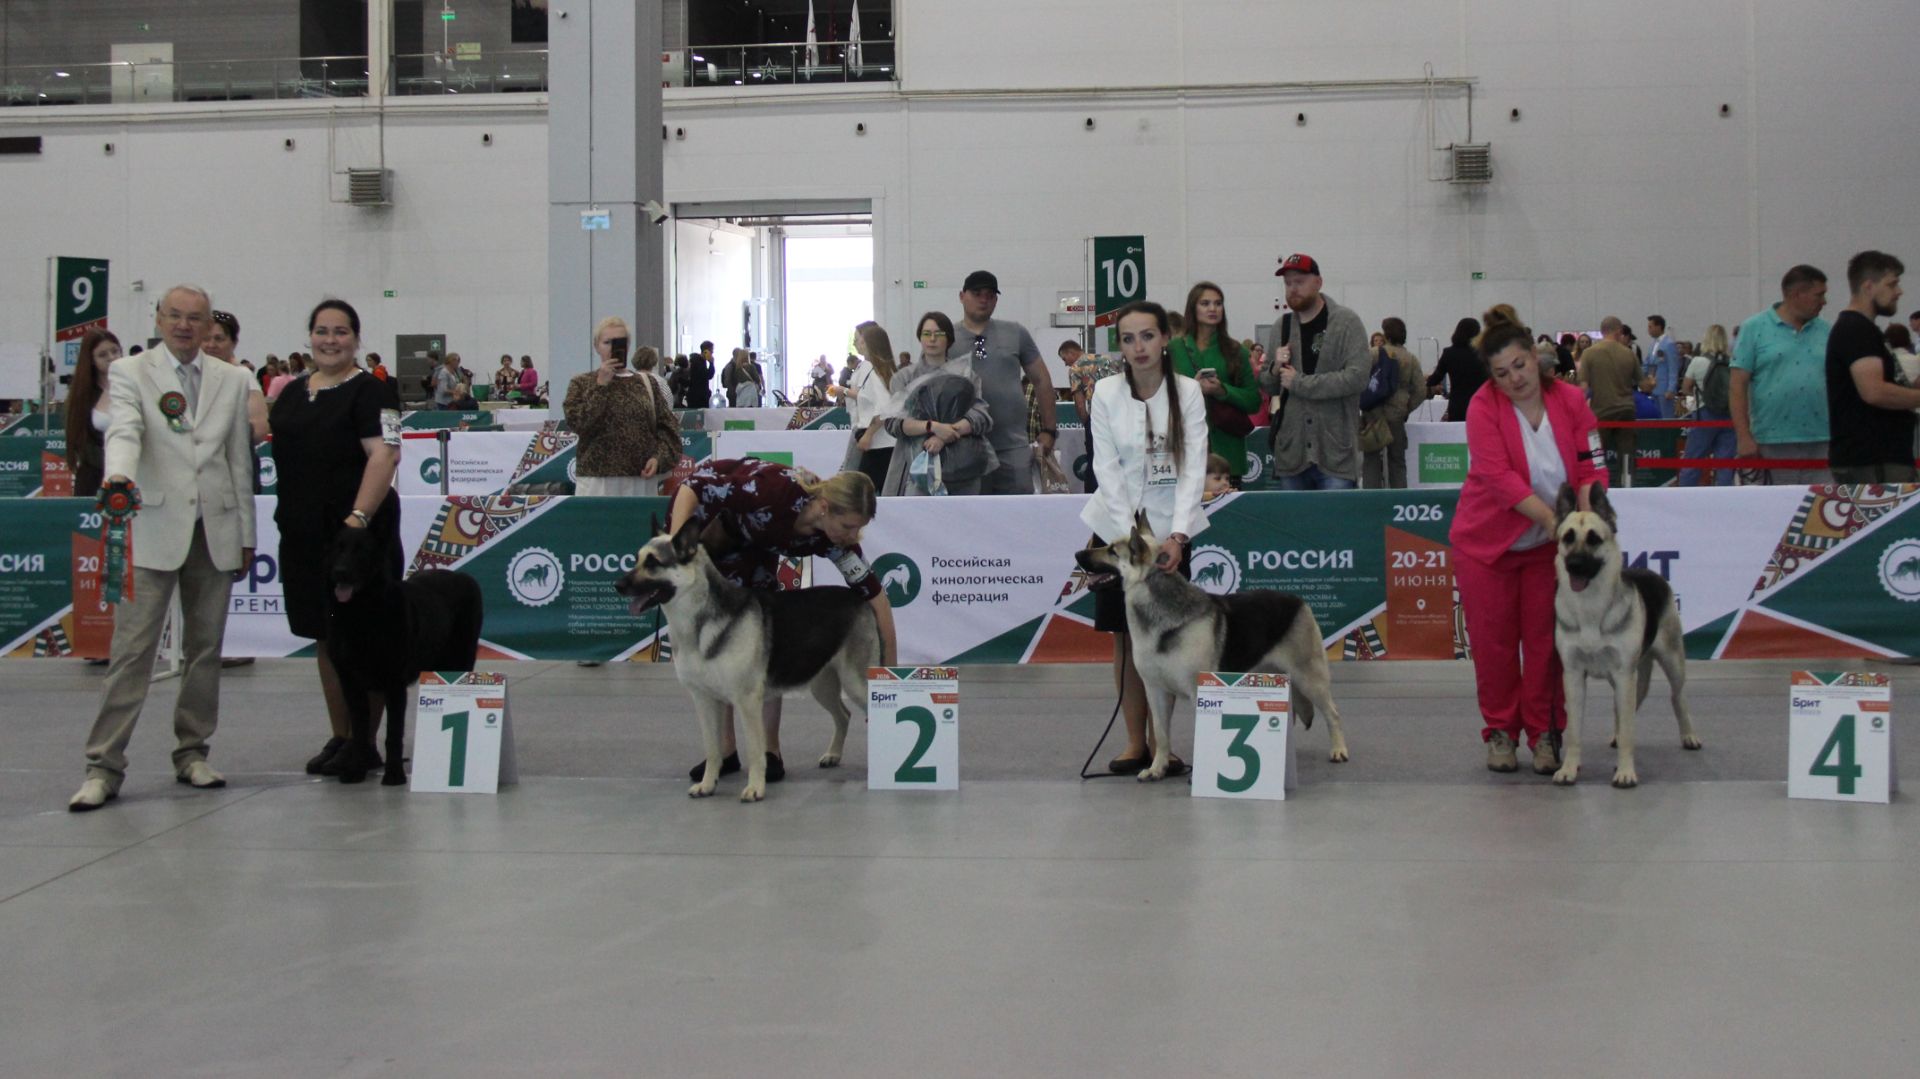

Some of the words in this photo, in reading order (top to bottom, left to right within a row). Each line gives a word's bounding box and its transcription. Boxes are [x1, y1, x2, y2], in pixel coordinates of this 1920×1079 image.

[1102, 259, 1139, 298] 10
[72, 276, 93, 314] 9
[1152, 465, 1171, 475] 344
[1392, 504, 1443, 522] 2026
[931, 555, 1011, 568] Российская
[1248, 549, 1353, 570] РОССИЯ
[1391, 550, 1446, 569] 20-21
[931, 574, 1044, 586] кинологическая
[1394, 575, 1447, 587] ИЮНЯ
[931, 590, 1009, 606] федерация
[419, 696, 444, 708] Брит
[871, 691, 897, 703] Брит
[1197, 697, 1223, 709] Брит
[1792, 697, 1821, 709] Брит
[441, 710, 469, 787] 1
[894, 705, 937, 783] 2
[1216, 713, 1261, 793] 3
[1808, 714, 1862, 795] 4
